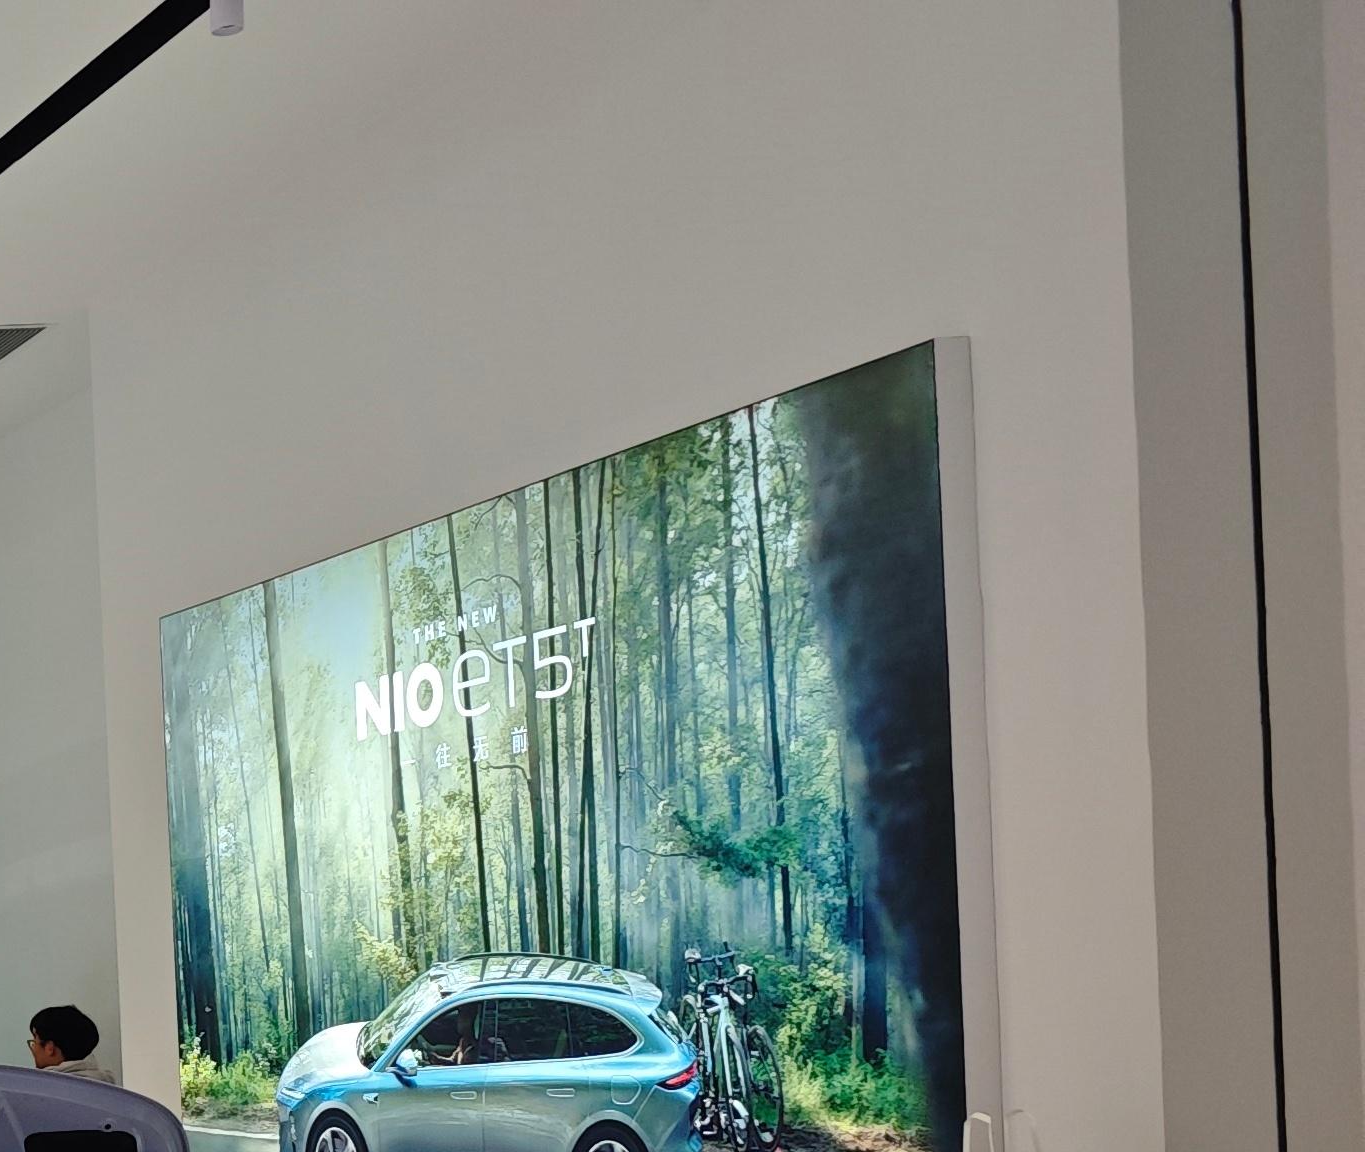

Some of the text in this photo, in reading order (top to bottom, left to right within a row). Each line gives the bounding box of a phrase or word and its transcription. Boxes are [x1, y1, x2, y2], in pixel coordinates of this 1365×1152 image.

[412, 604, 498, 644] THE NEW
[354, 662, 444, 742] NIO
